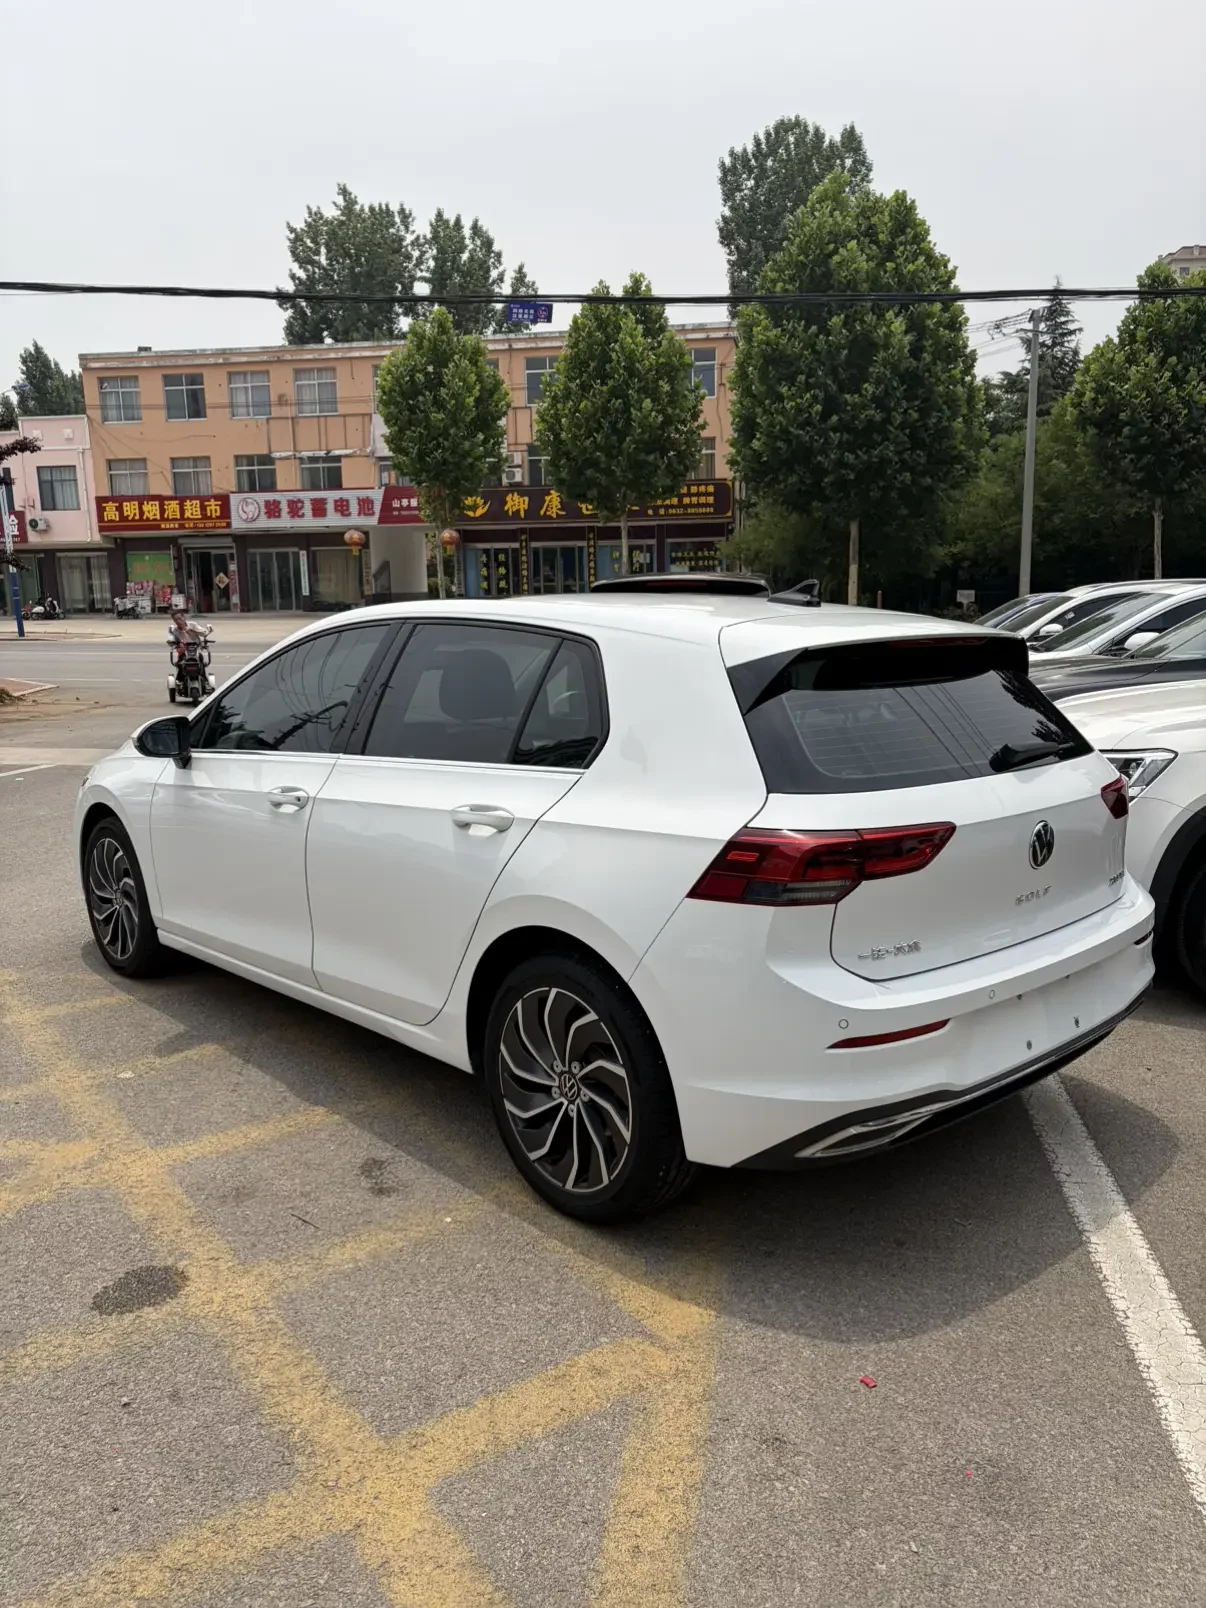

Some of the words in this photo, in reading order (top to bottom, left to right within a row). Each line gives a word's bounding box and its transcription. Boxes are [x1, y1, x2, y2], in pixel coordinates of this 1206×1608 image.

[102, 499, 221, 521] 高明烟酒超市
[264, 497, 375, 519] 骆驼蓄电池
